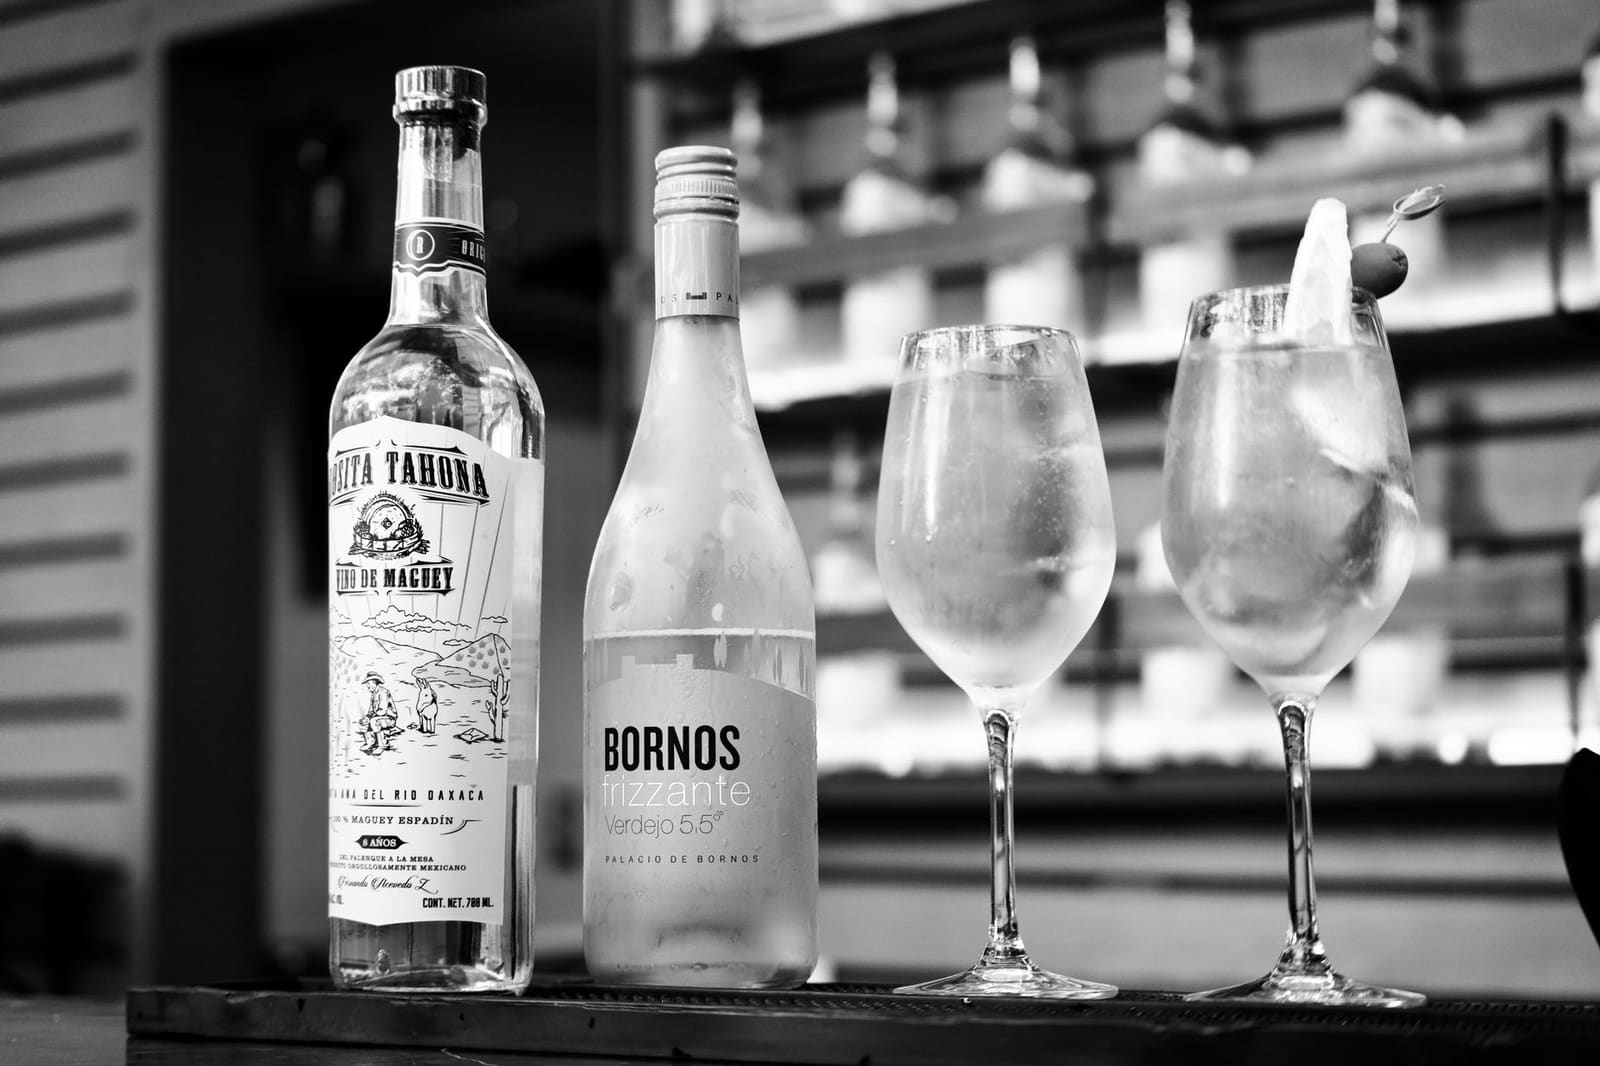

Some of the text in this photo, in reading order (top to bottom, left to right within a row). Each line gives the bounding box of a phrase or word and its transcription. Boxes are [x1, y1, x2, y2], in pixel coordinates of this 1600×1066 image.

[330, 451, 489, 498] OSITA TAHONA
[336, 567, 453, 589] VINO DE MAGUEY
[604, 725, 741, 771] BORNOS
[363, 788, 385, 800] DEL
[394, 789, 417, 801] RIO
[428, 789, 484, 801] OAXACA
[602, 774, 751, 807] frizzante
[351, 815, 394, 824] MAGUEY
[398, 814, 454, 825] ESPADÍN
[604, 814, 674, 839] Verdejo
[369, 836, 397, 848] AÑOS
[410, 855, 434, 863] MESA
[605, 854, 759, 864] PALACIO DE BORNOS
[420, 863, 467, 872] MEXICANO
